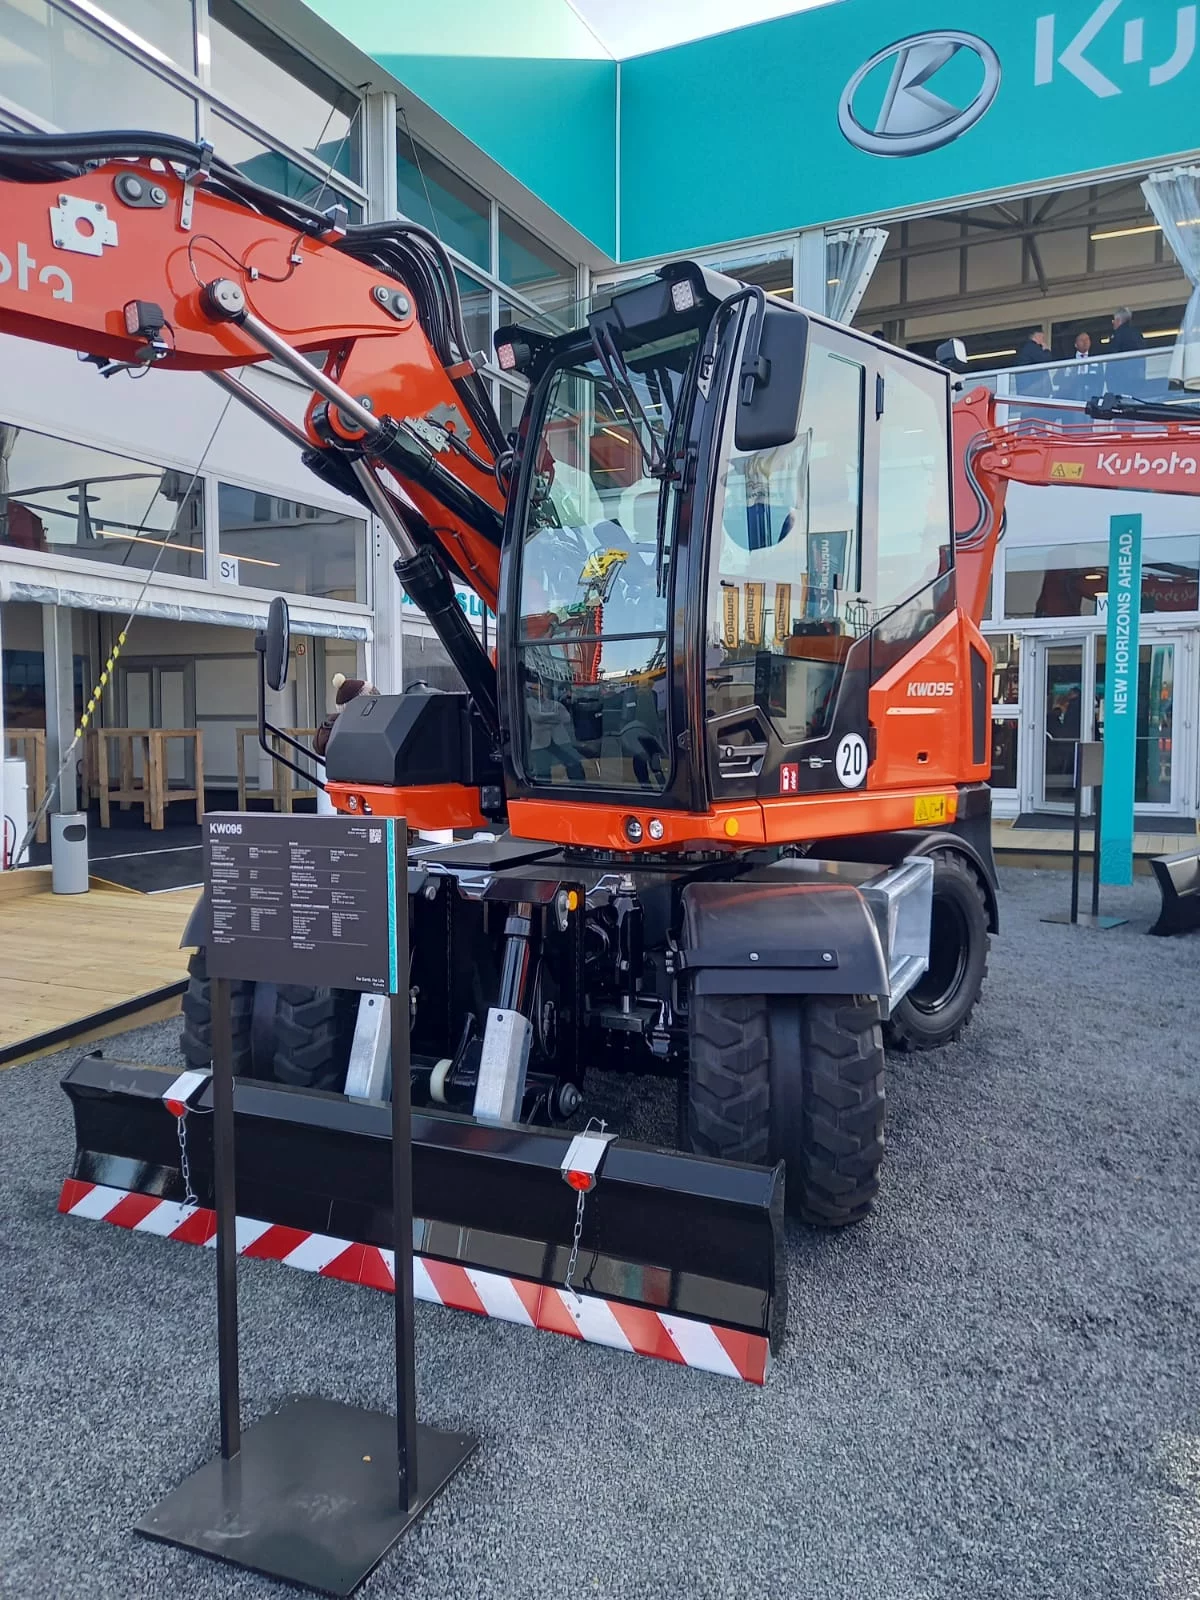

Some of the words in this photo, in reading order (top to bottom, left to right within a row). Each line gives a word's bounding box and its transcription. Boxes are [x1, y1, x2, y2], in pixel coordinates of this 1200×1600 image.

[1097, 452, 1197, 475] Kubota
[221, 561, 236, 580] S1
[1118, 529, 1133, 588] AHEAD.
[1115, 592, 1131, 674] HORIZONS
[906, 682, 954, 697] KW095
[1114, 679, 1127, 714] NEW
[842, 743, 862, 776] 20
[210, 823, 243, 834] KW095
